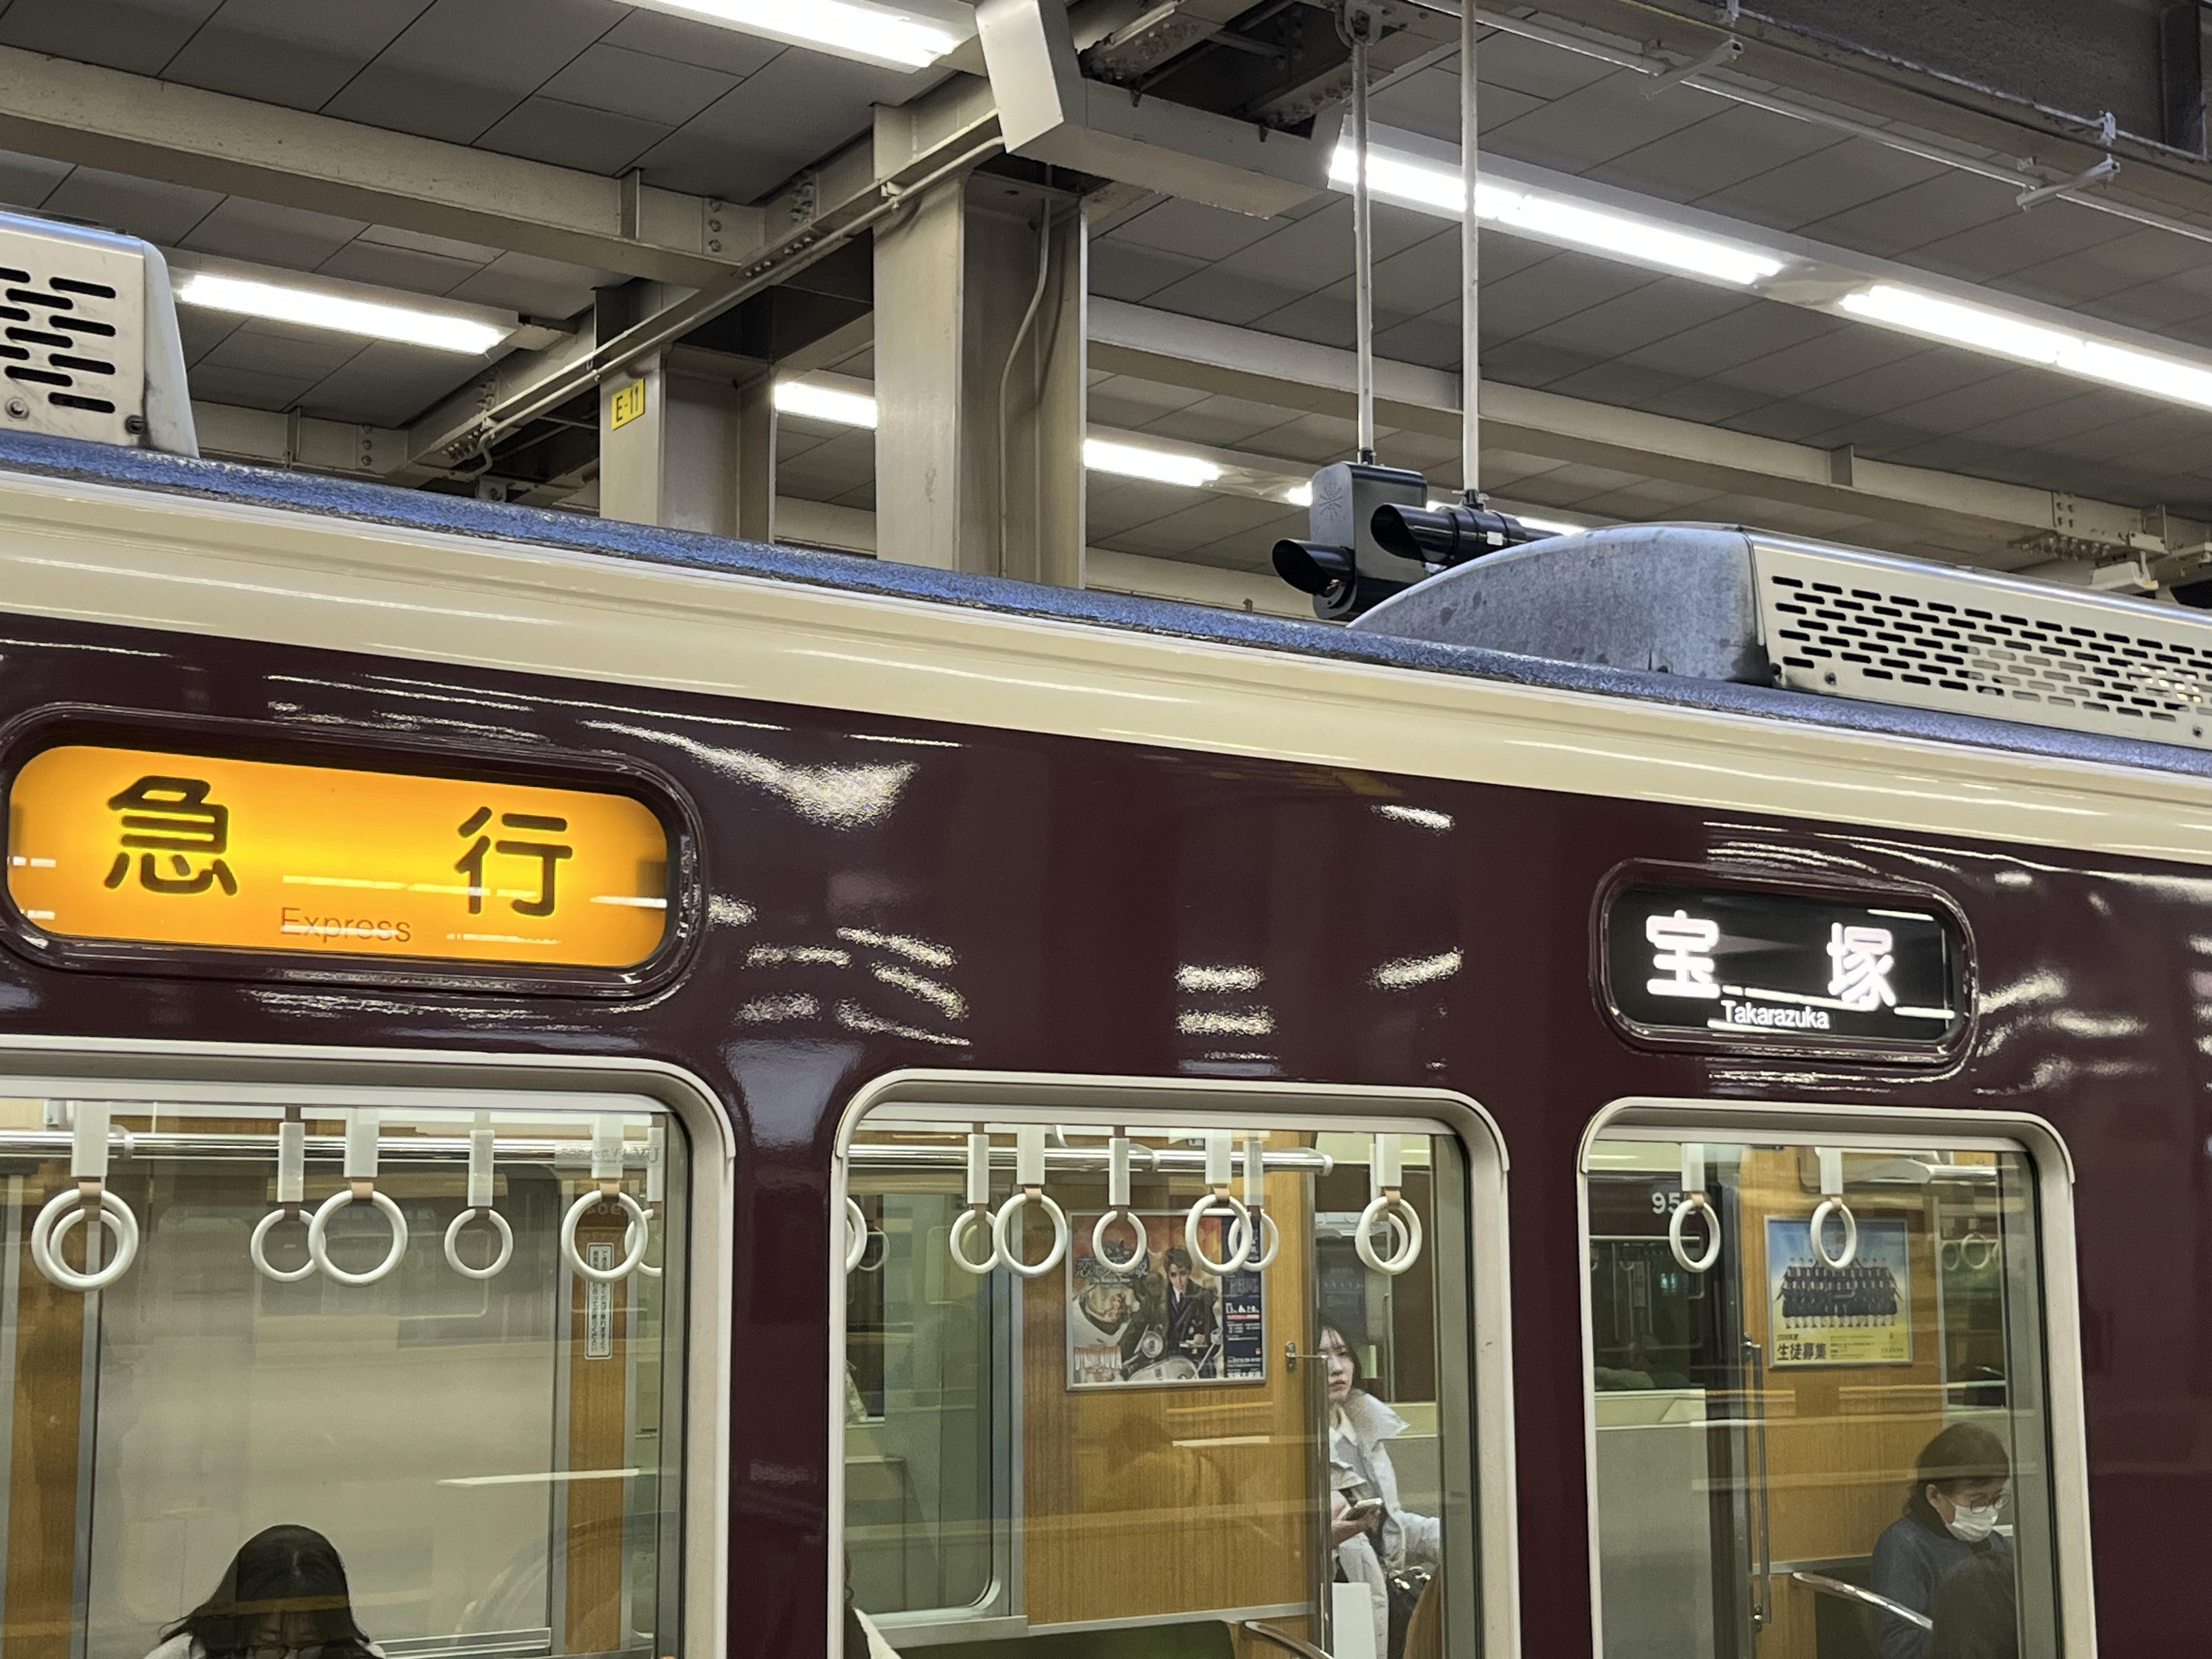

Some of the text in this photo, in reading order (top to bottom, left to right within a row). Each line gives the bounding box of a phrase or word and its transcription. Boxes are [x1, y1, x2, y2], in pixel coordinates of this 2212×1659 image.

[616, 386, 639, 422] E-11
[104, 774, 573, 917] 急行
[280, 906, 412, 944] Express
[1646, 909, 1896, 1009] 宝塚
[1720, 1000, 1830, 1029] Takarazuka
